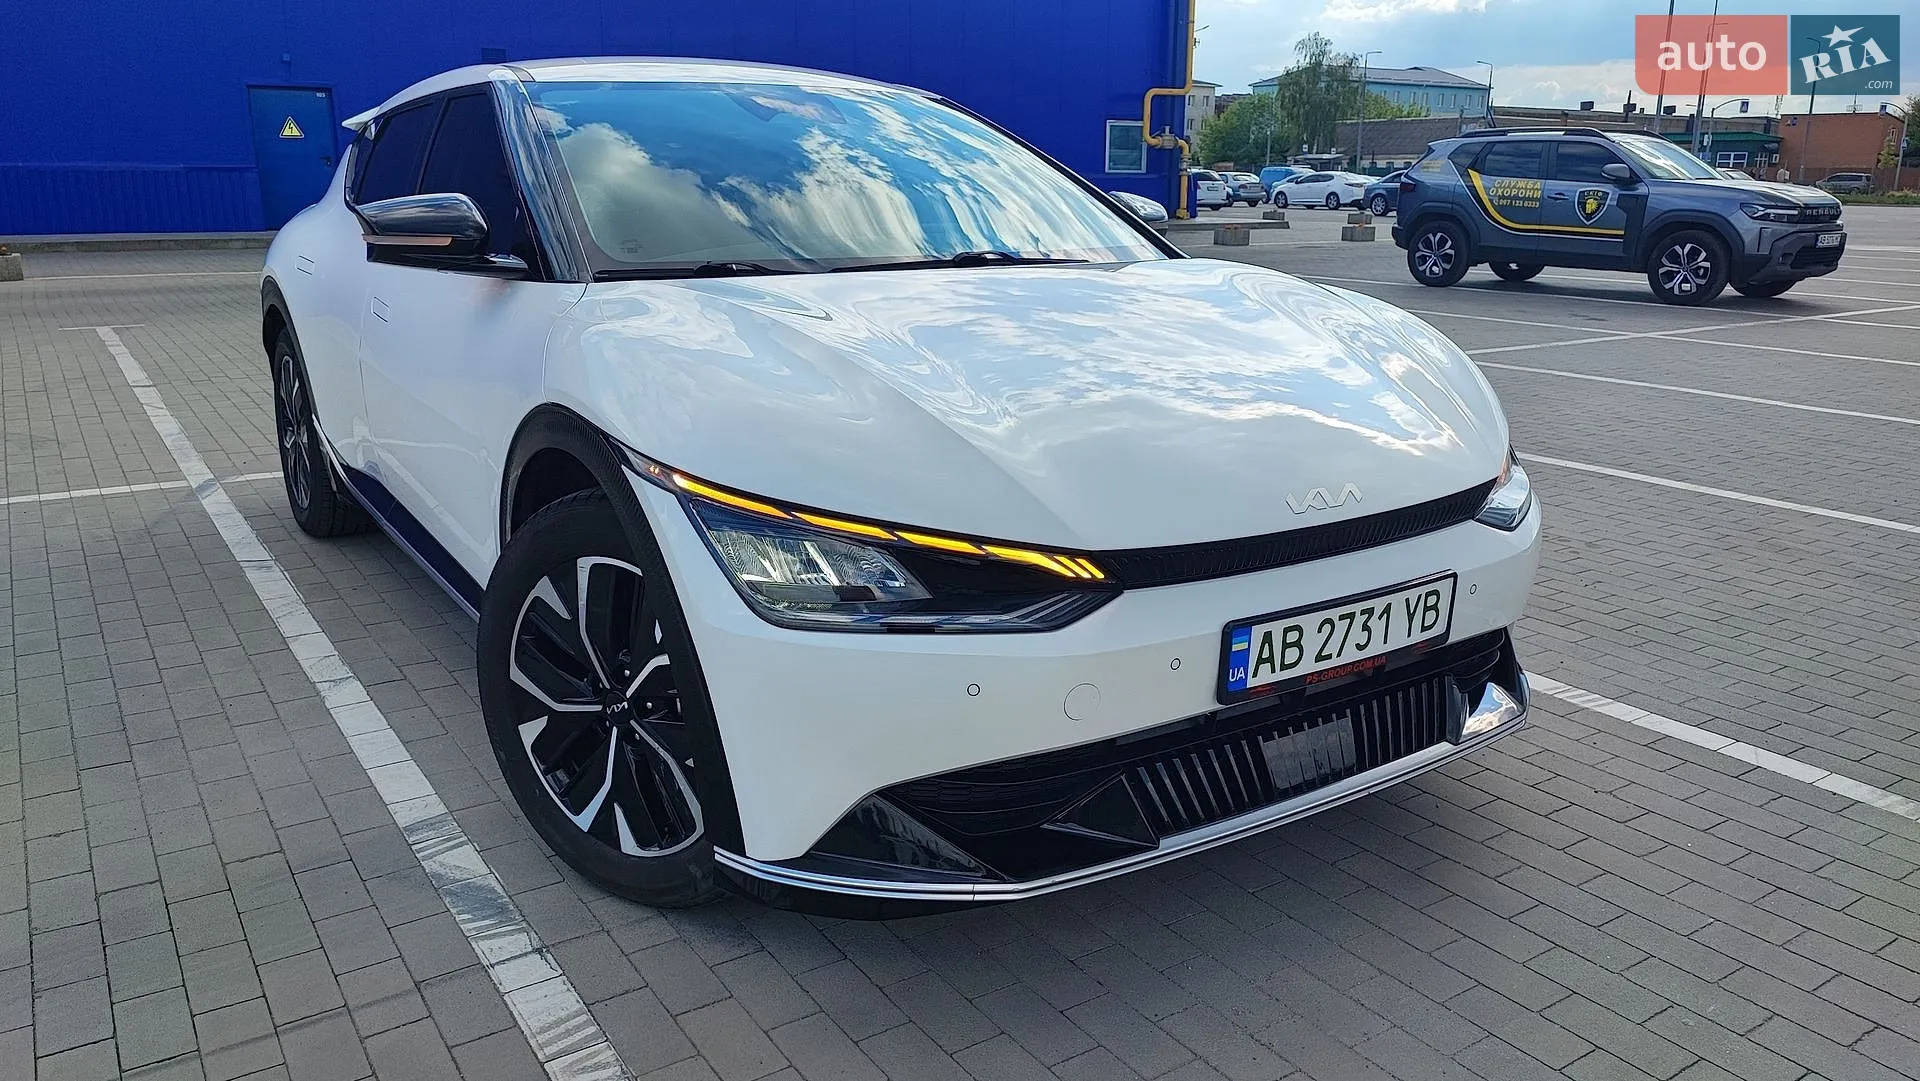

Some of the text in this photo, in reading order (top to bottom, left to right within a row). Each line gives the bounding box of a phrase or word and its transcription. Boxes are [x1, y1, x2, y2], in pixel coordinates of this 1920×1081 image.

[1494, 179, 1541, 190] СЛУЖБА
[1489, 187, 1542, 199] ОХОРОНИ
[1806, 206, 1842, 216] RENAULT
[1252, 588, 1441, 678] AB 2731 YB
[1229, 666, 1246, 683] UA
